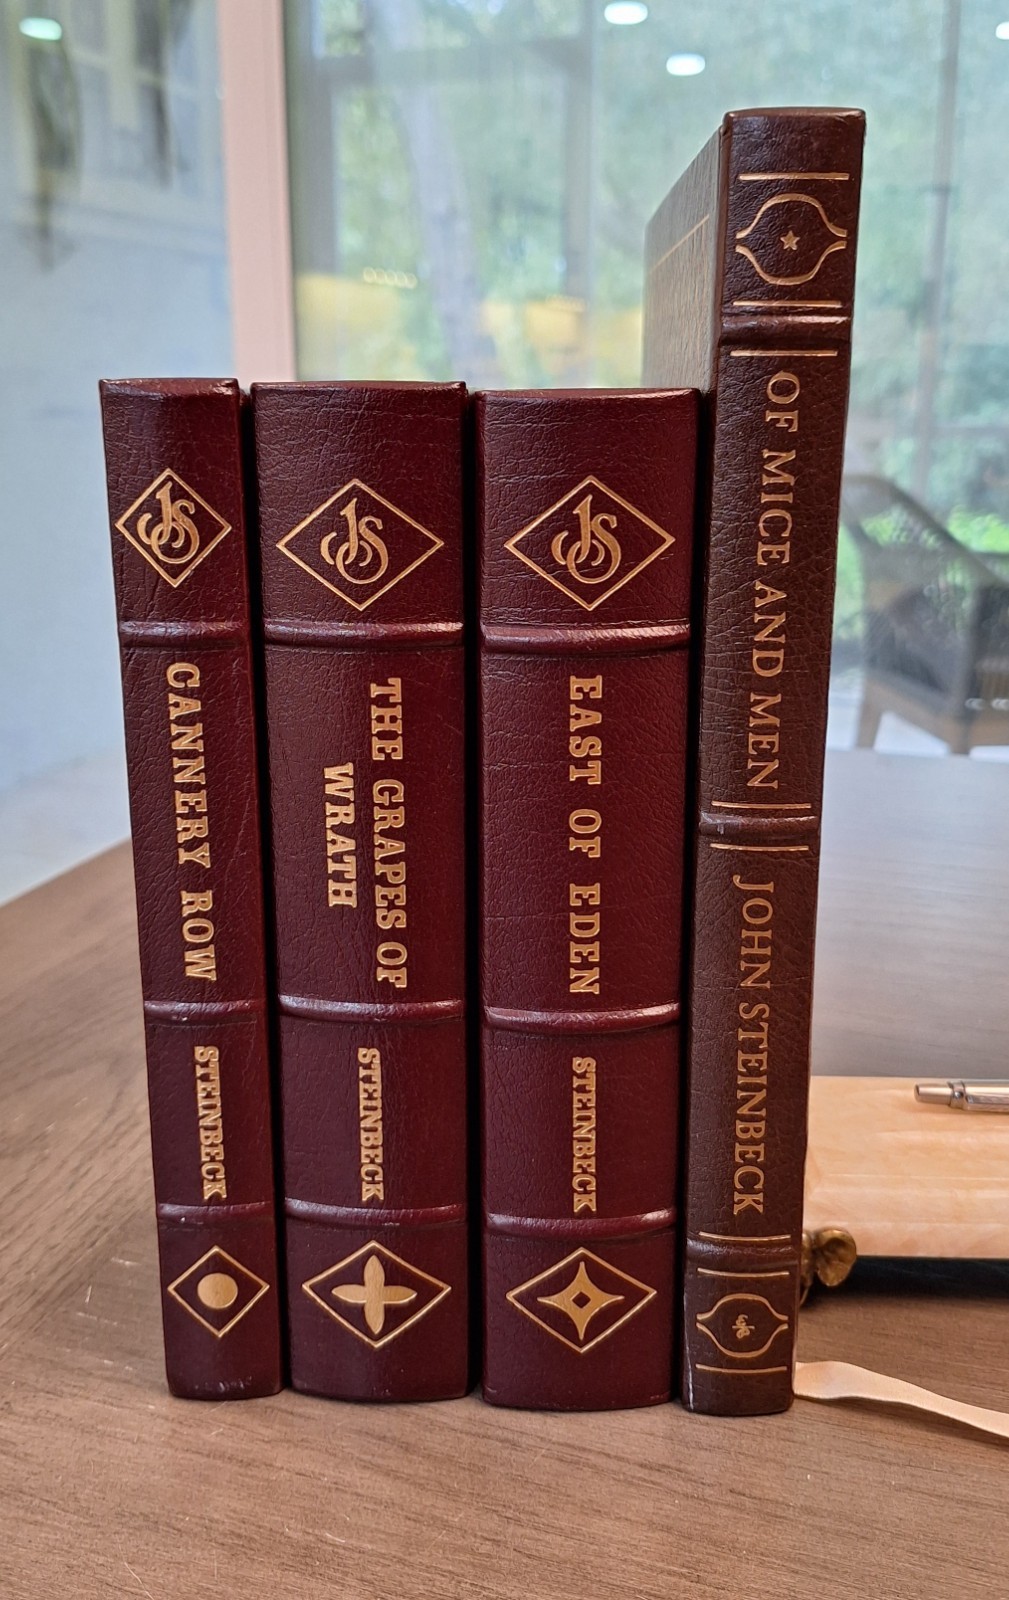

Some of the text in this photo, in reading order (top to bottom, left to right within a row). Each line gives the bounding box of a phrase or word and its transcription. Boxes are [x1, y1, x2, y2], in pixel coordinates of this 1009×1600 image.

[746, 370, 801, 791] OF MICE AND MEN
[165, 661, 217, 982] CANNERY ROW
[322, 761, 358, 910] WRATH
[369, 676, 409, 990] THE GRAPES OF
[567, 674, 603, 996] EAST OF EDEN
[193, 1044, 228, 1202] STEINBECK
[356, 1046, 385, 1203] STEINBECK
[571, 1055, 598, 1214] STEINBECK
[732, 873, 775, 1217] JOHN STEINBECK
